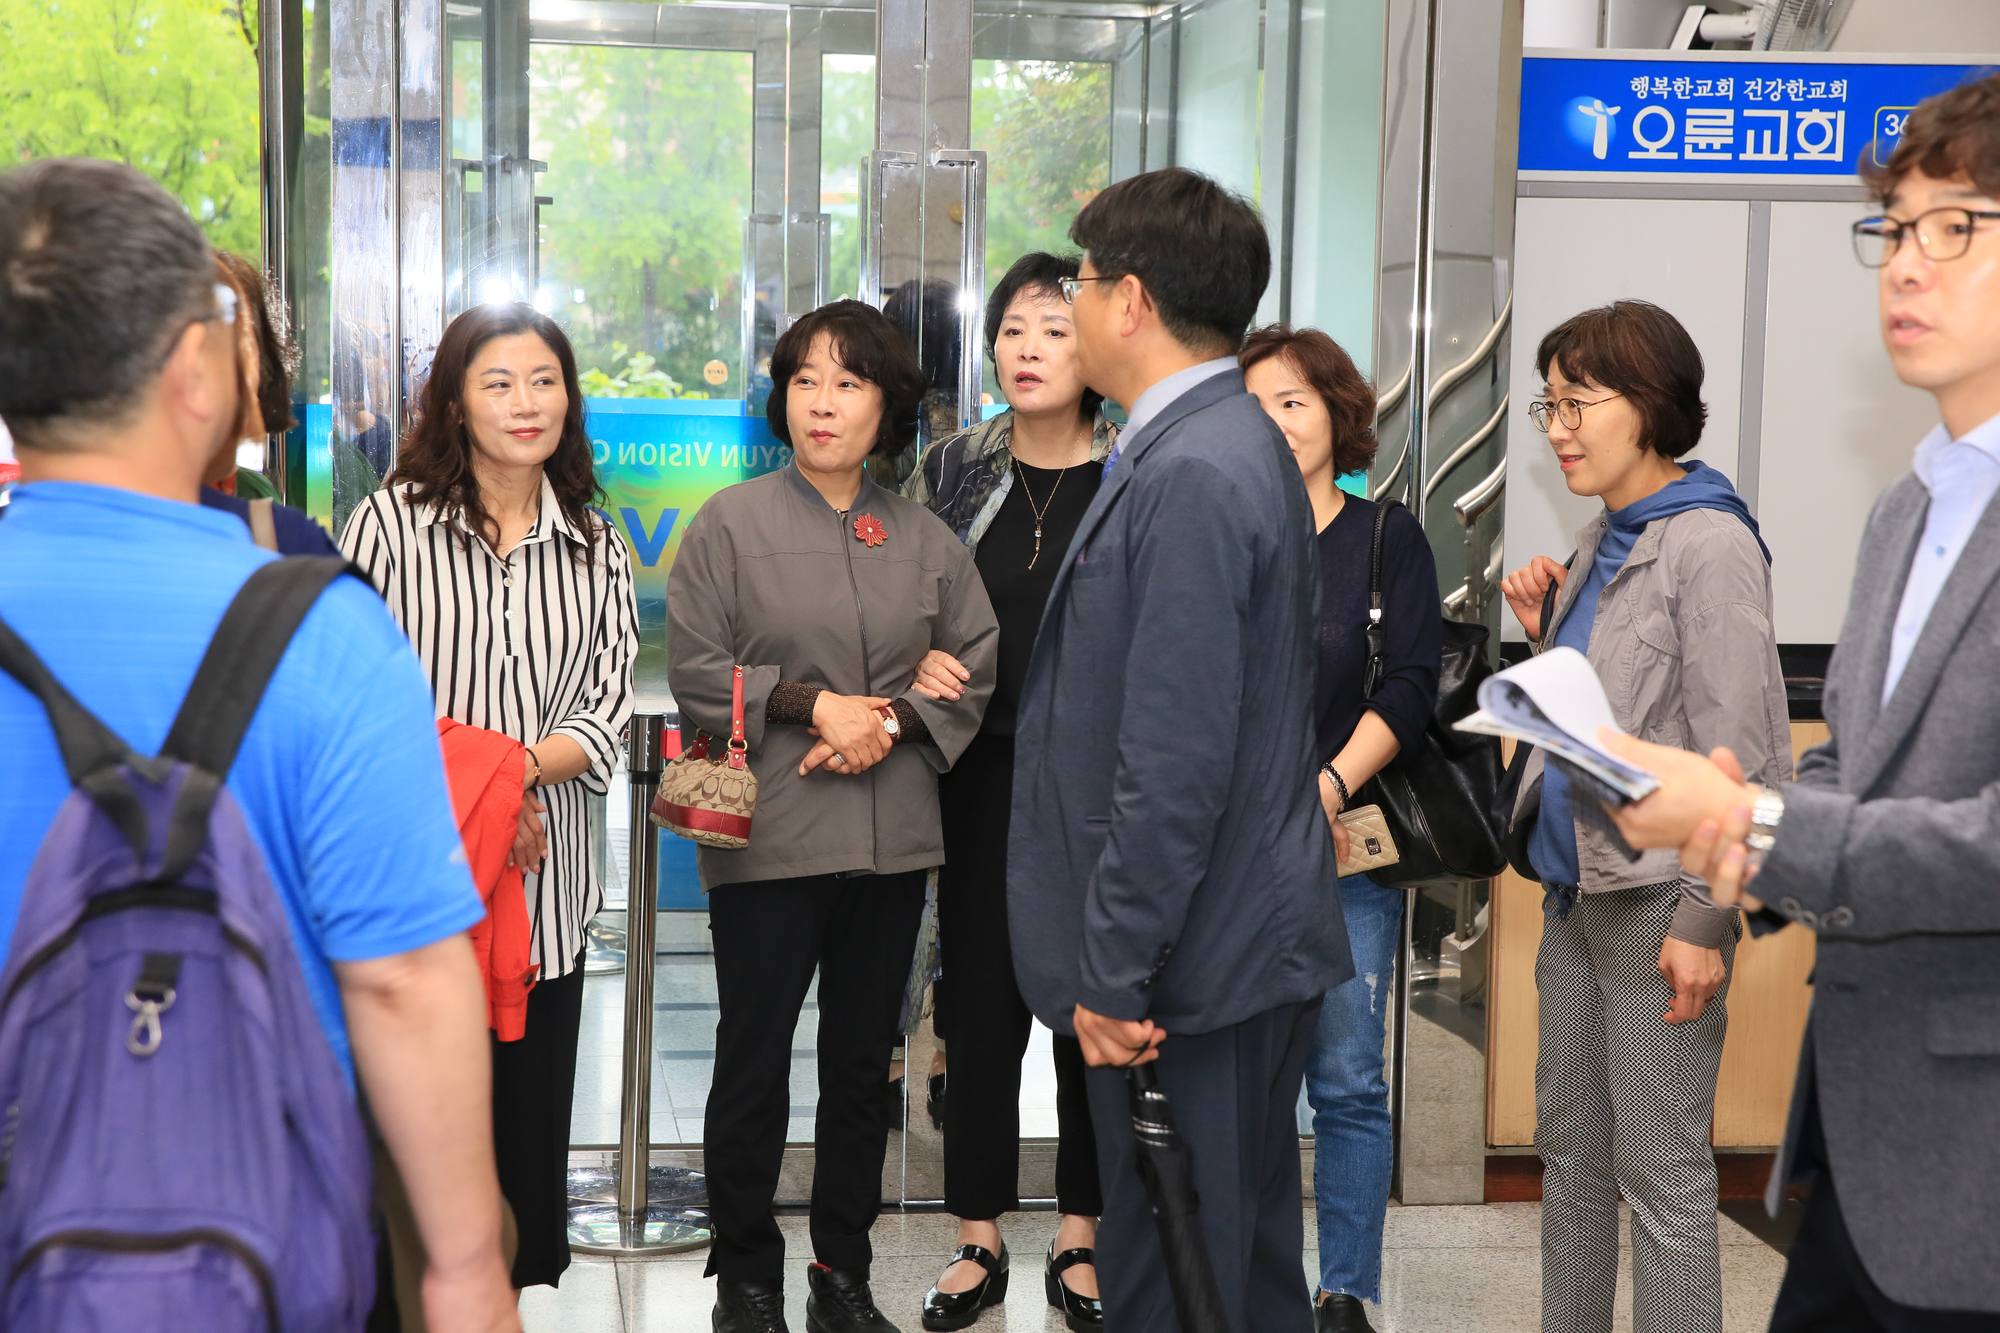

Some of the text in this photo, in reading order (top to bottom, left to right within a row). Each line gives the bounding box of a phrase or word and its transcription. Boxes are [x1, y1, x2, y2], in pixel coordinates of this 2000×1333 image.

[1629, 76, 1848, 103] 행복한교회 건강한교회
[1628, 104, 1846, 162] 오륜교회
